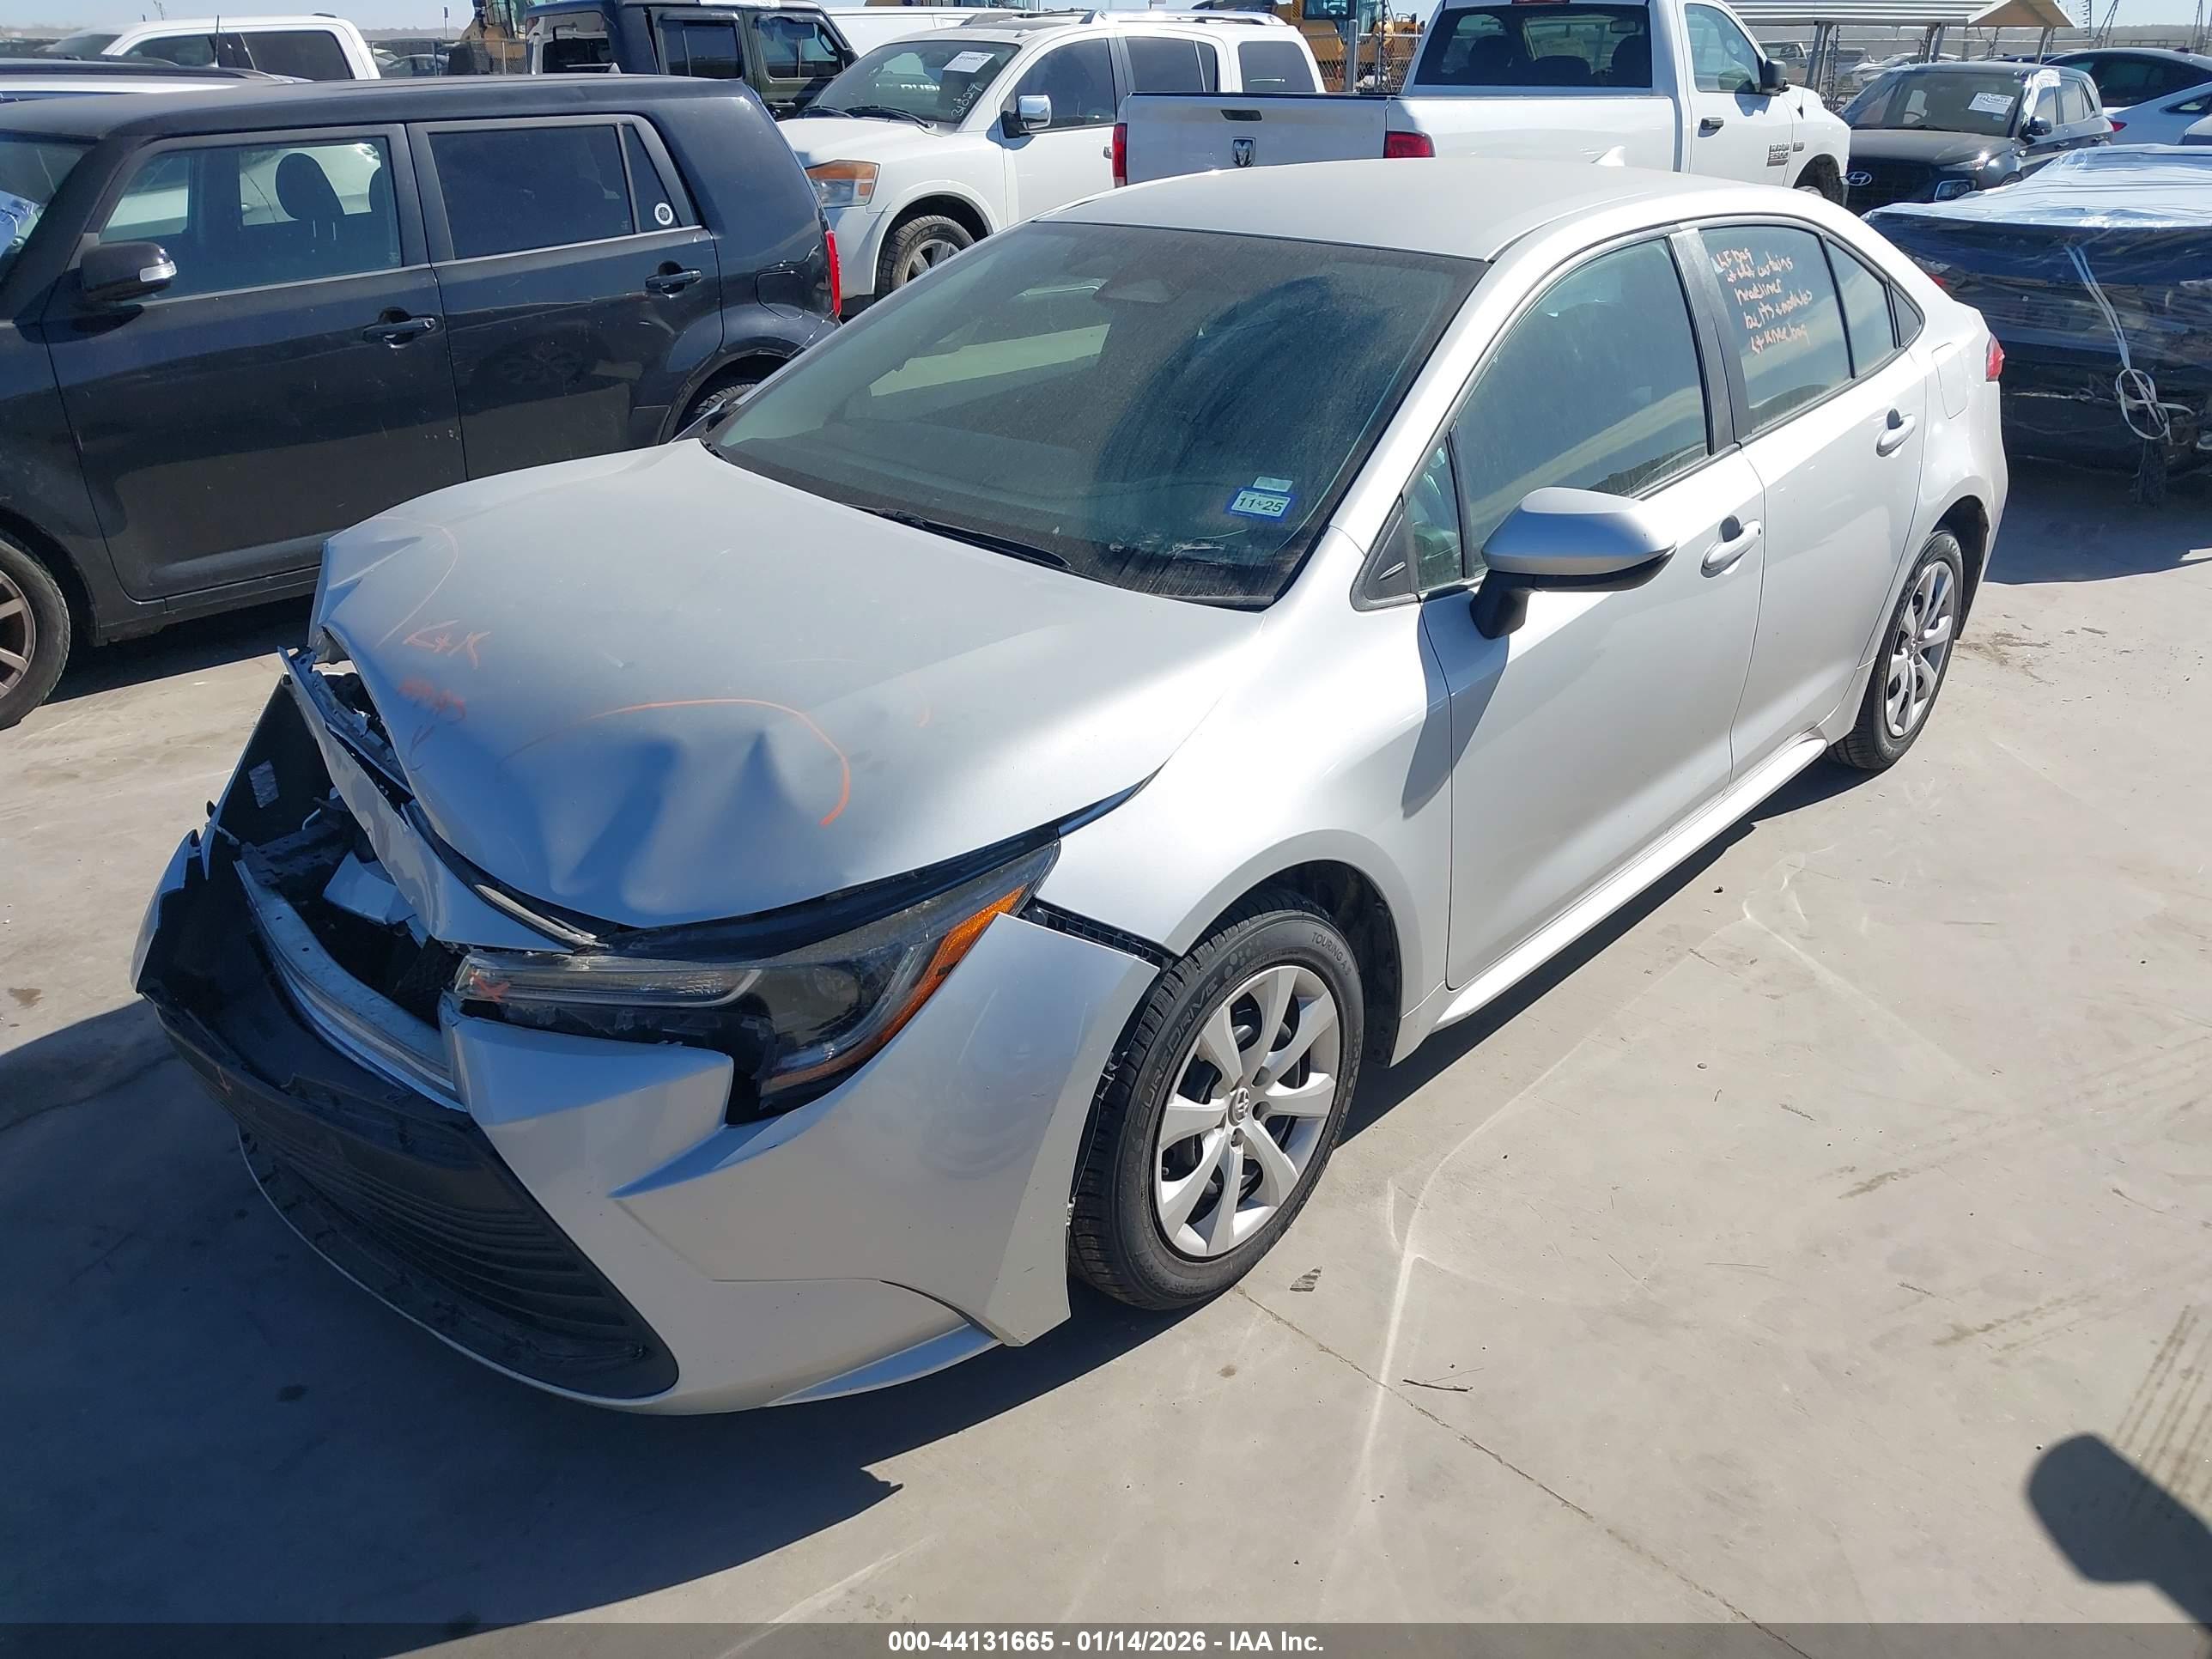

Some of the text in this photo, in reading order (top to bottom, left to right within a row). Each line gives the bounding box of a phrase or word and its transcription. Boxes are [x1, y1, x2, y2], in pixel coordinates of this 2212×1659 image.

[1769, 143, 1790, 152] RAM
[1239, 497, 1256, 508] 11
[1261, 500, 1284, 513] 25
[1311, 932, 1344, 962] TOURING
[1137, 976, 1219, 1129] SUREDRIVE
